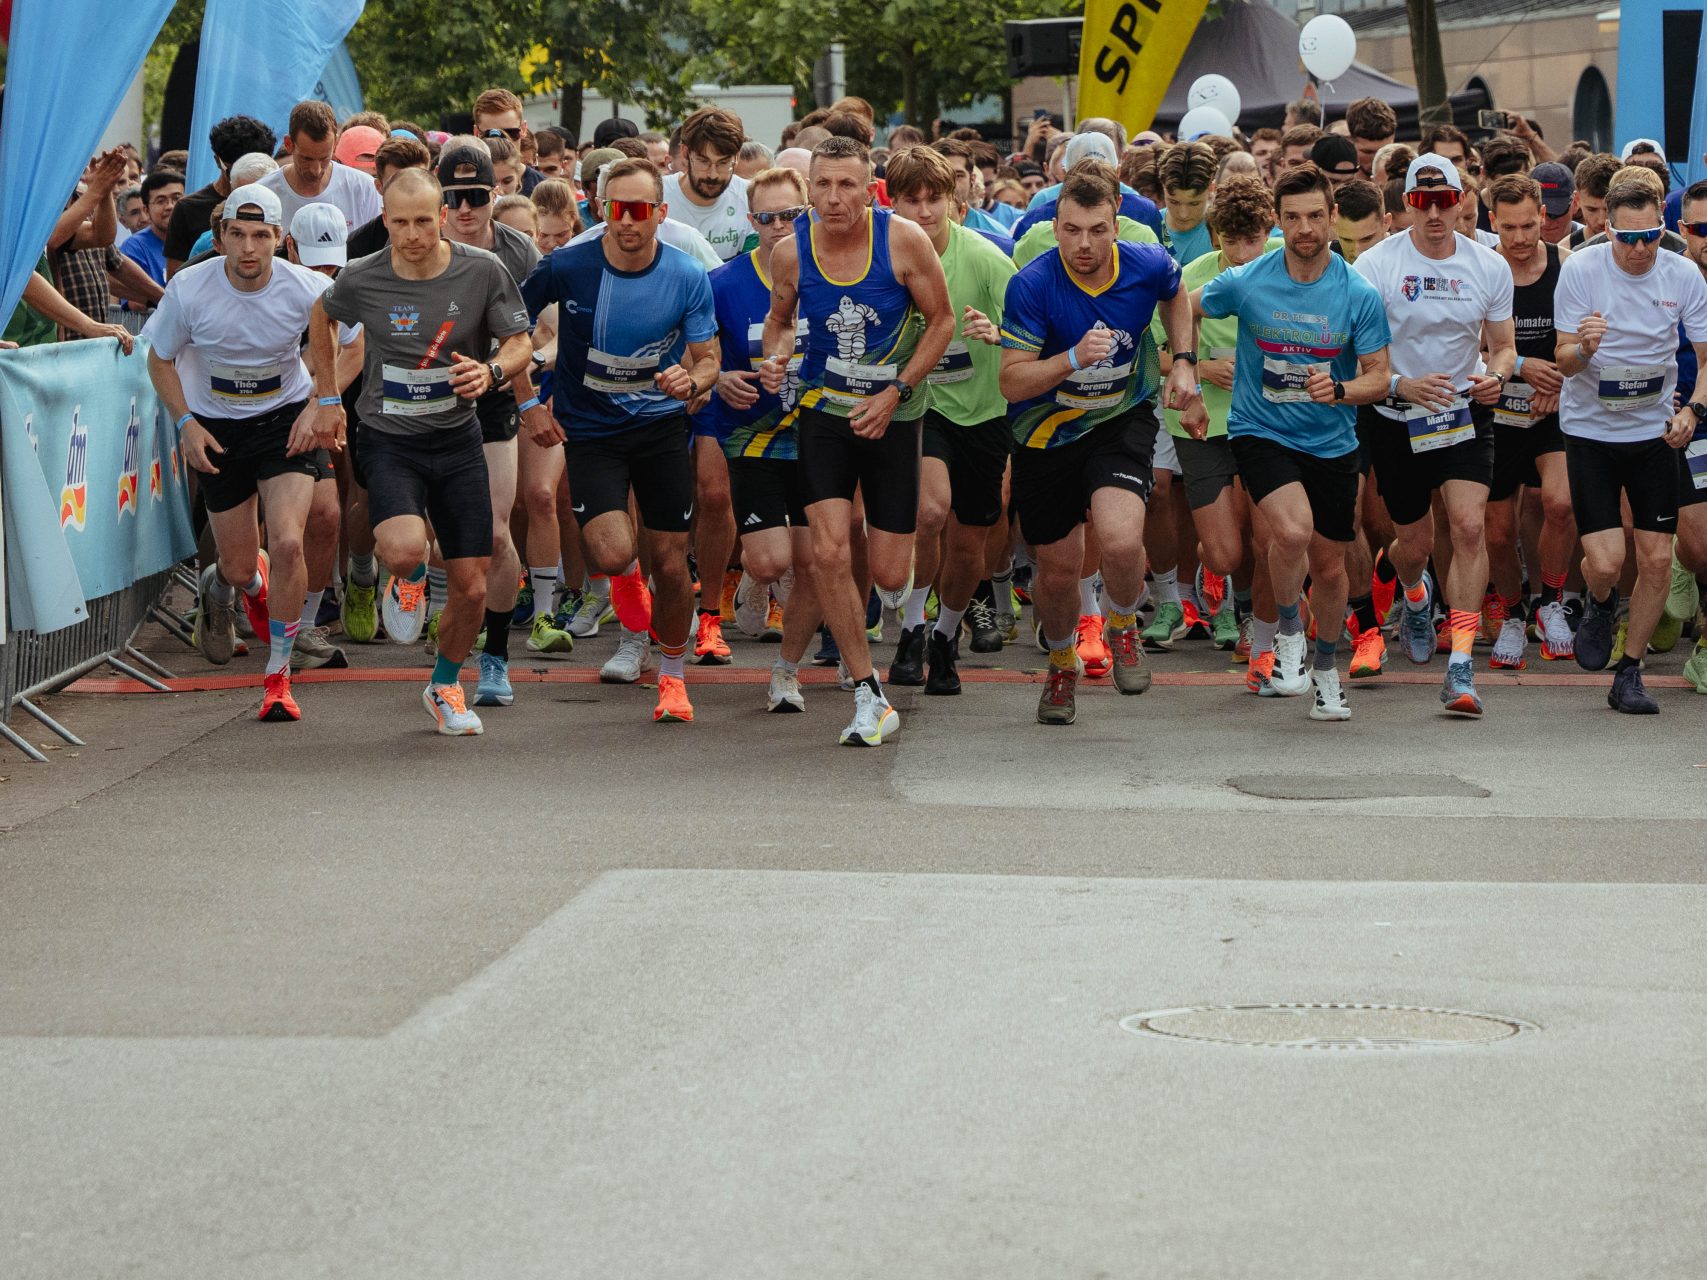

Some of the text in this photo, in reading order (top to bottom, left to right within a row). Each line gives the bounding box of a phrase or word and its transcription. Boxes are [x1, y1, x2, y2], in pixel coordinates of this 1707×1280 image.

[704, 227, 742, 248] lanty
[1515, 316, 1552, 328] lomaten
[606, 366, 637, 376] Marco
[406, 384, 431, 393] Yves
[846, 378, 872, 389] Marc
[1077, 382, 1113, 391] Jeremy
[1619, 381, 1648, 390] Stefan
[1505, 398, 1532, 412] 465
[1426, 412, 1455, 426] Martin
